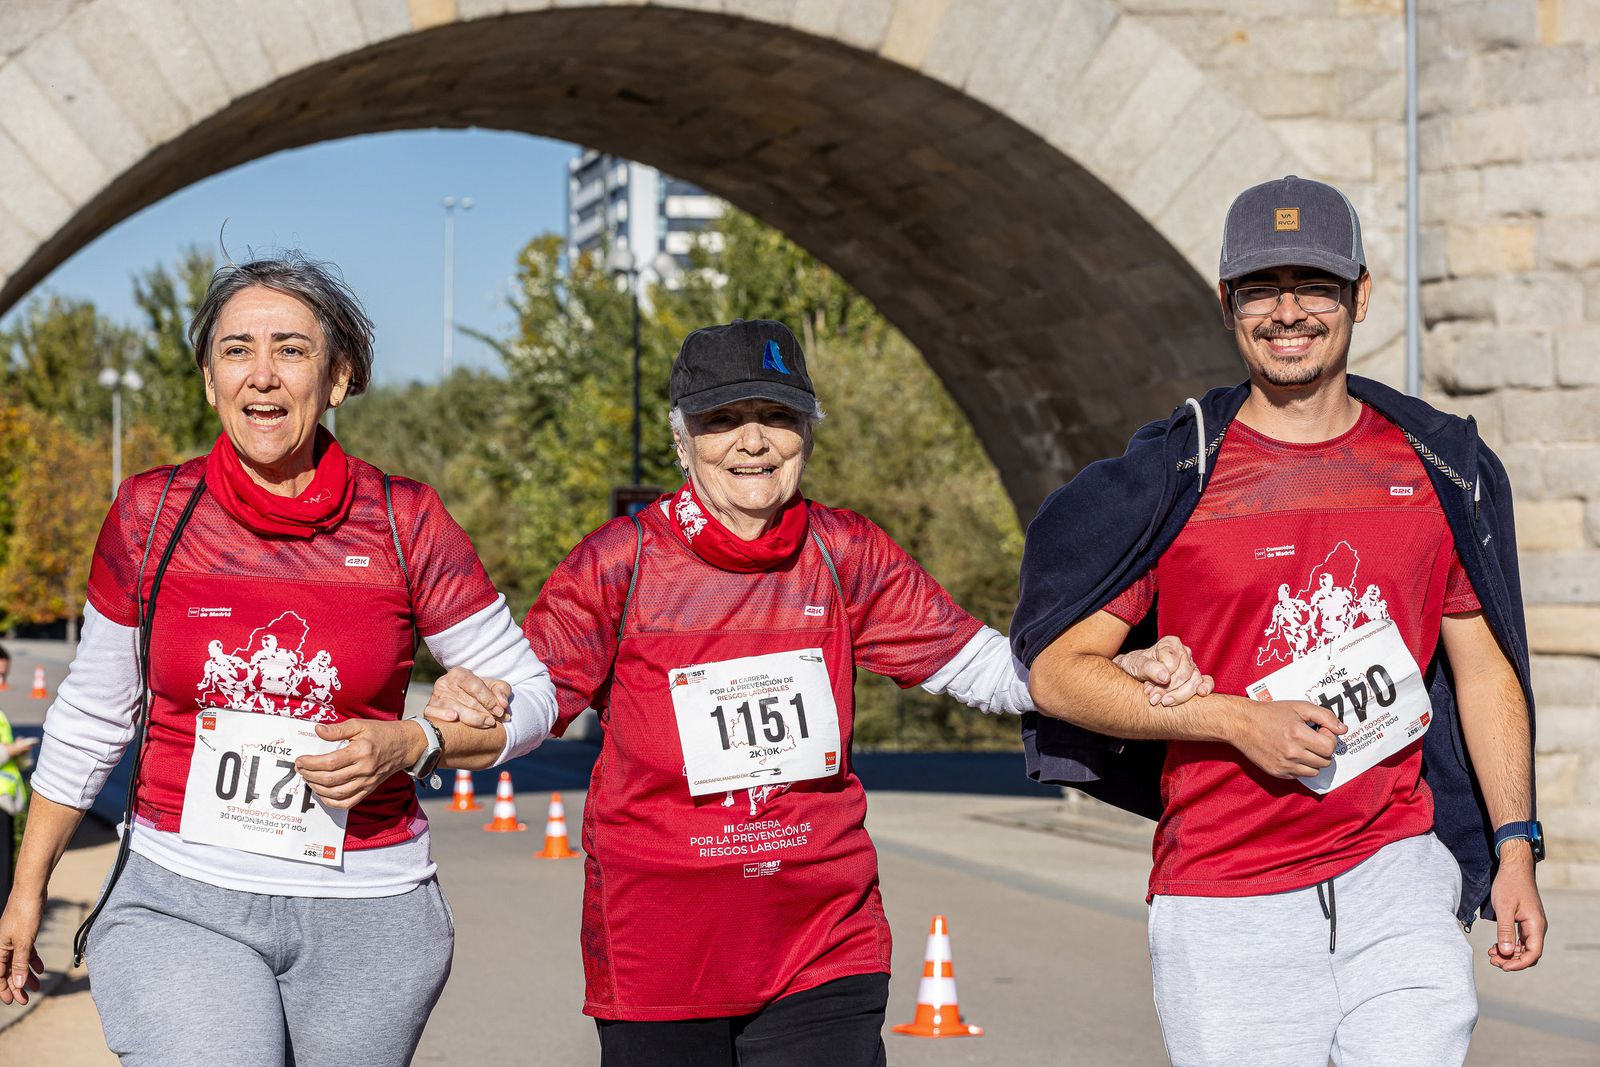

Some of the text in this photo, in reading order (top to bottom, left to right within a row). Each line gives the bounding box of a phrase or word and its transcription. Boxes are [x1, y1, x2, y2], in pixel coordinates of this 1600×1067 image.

[1266, 544, 1295, 552] Comunidad
[1276, 549, 1295, 557] Madrid
[709, 688, 726, 696] POR
[736, 677, 783, 692] PREVENCIÓN
[784, 676, 794, 684] DE
[738, 674, 770, 684] CARRERA
[717, 685, 790, 702] RIESGOS LABORALES
[710, 692, 809, 750] 1151
[1364, 712, 1391, 731] RIESGOS
[1377, 723, 1385, 731] LA
[1386, 715, 1399, 727] POR
[1348, 737, 1377, 755] CARRERA
[215, 751, 315, 813] 1210
[226, 805, 303, 824] RIESGOS LABORALES
[230, 814, 280, 829] PREVENCIÓN
[242, 824, 275, 835] CARRERA
[291, 825, 307, 833] POR
[690, 822, 812, 846] POR LA PREVENCIÓN DE
[724, 819, 781, 833] III CARRERA
[699, 835, 808, 857] RIESGOS LABORALES
